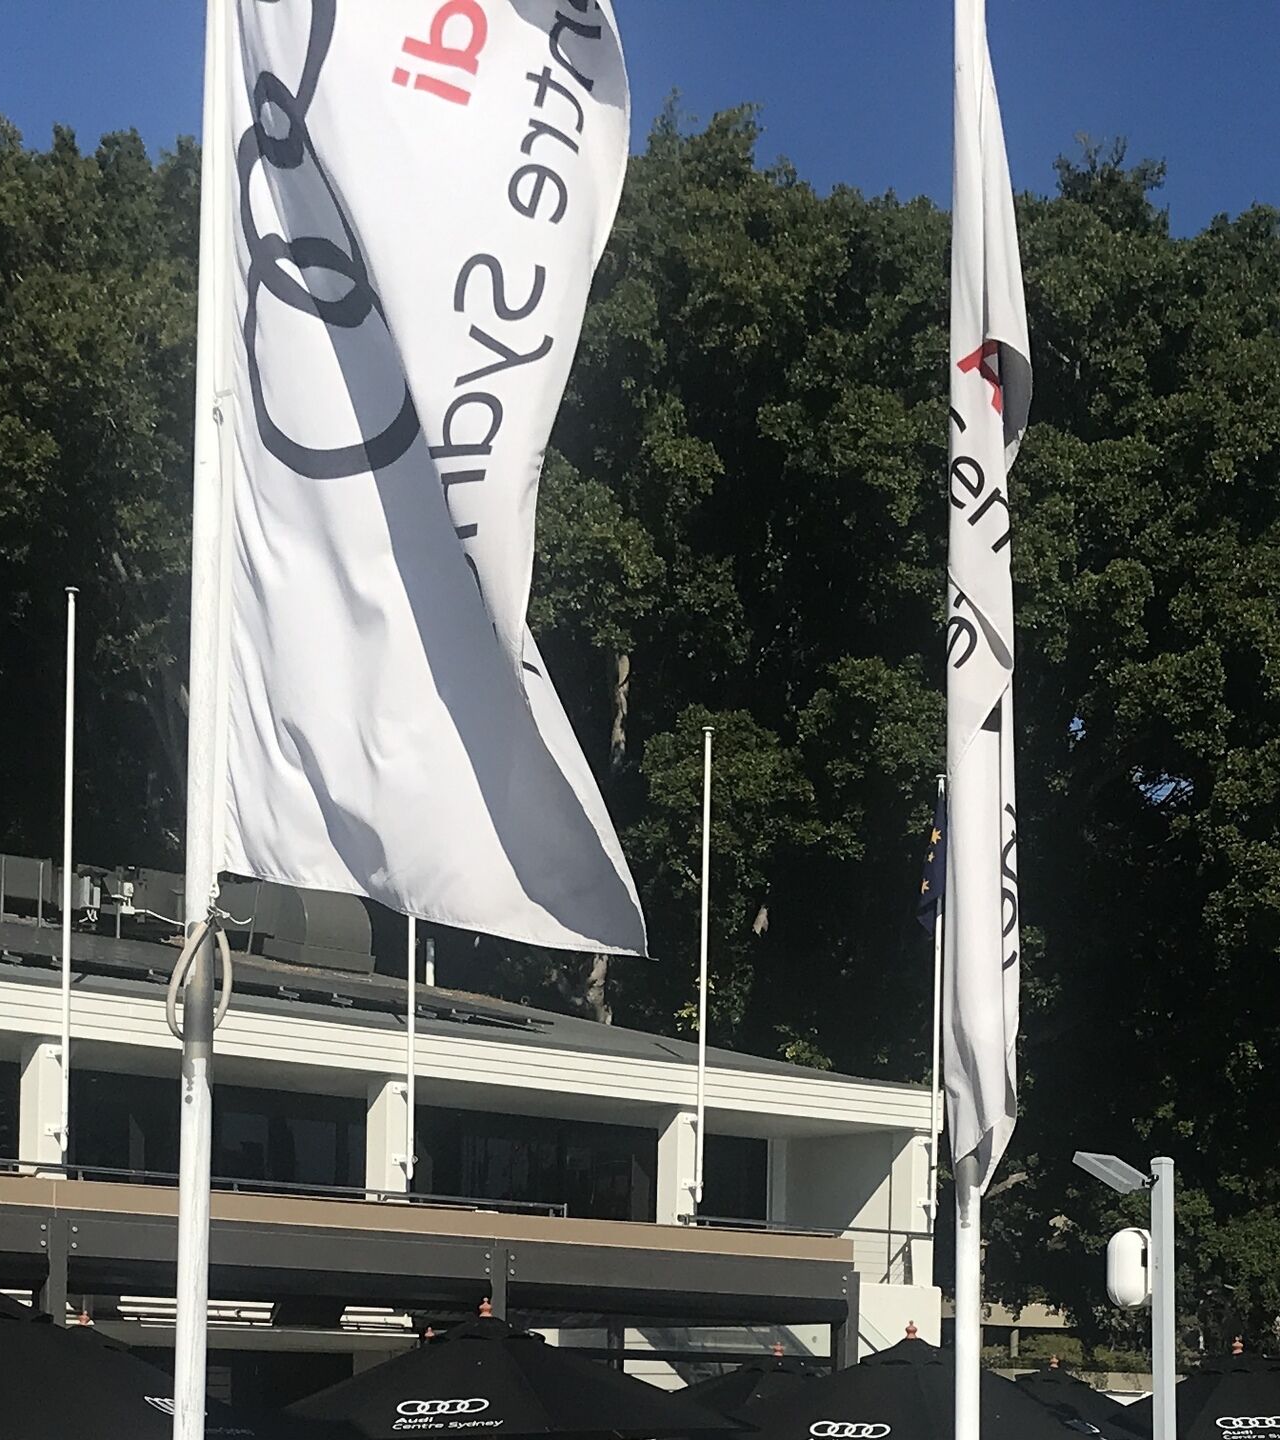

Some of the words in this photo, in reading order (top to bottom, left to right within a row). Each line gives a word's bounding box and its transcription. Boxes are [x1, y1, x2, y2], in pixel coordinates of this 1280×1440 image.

[392, 1422, 444, 1431] Centre
[448, 1419, 504, 1430] Sydney
[395, 1416, 433, 1424] Audi
